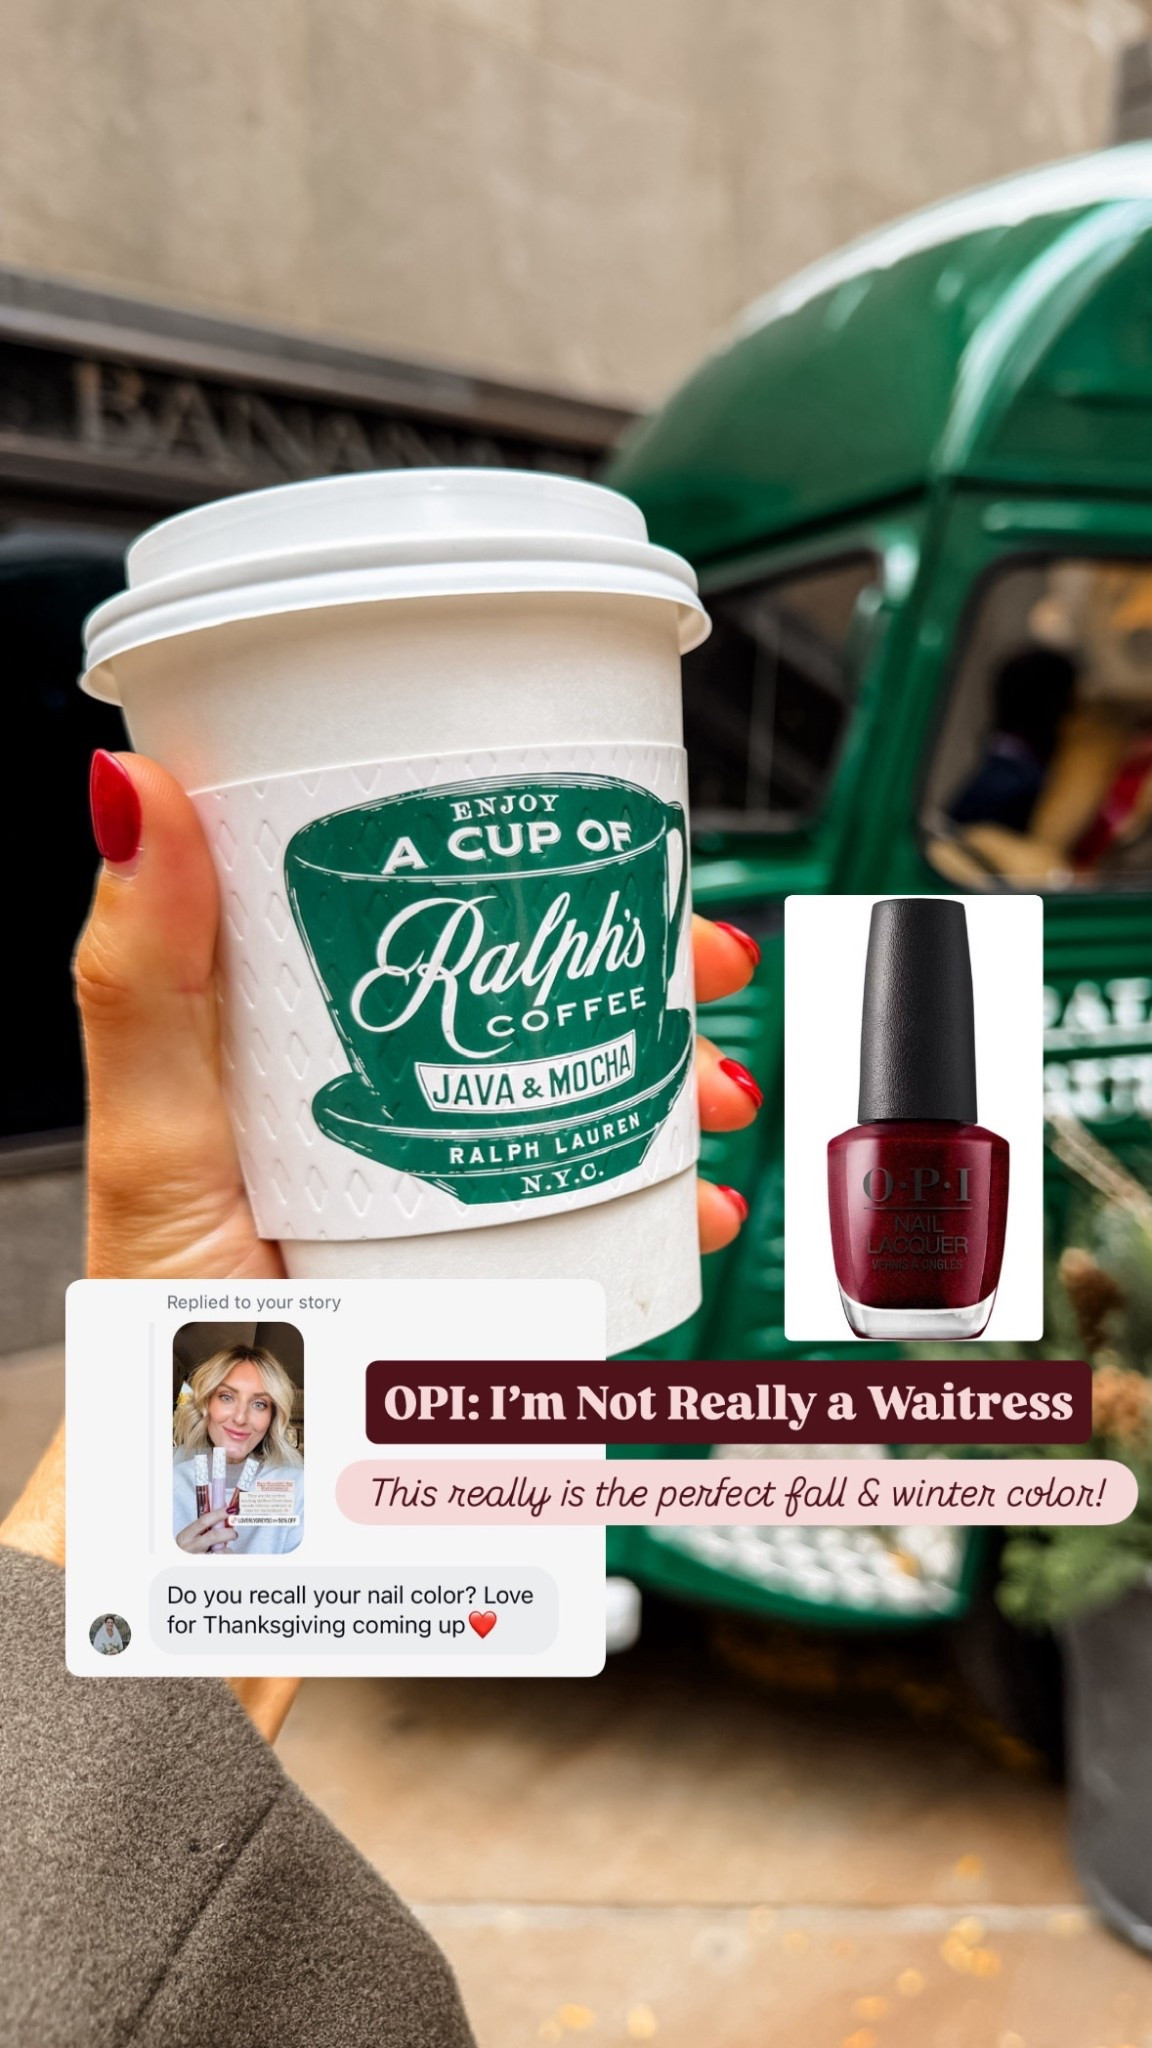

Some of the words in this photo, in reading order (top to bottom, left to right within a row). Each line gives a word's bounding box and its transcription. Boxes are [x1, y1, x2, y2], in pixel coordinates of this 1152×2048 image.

[450, 794, 559, 822] ENJOY
[381, 836, 429, 875] A
[447, 821, 562, 861] CUP
[576, 819, 632, 852] OF
[350, 890, 646, 1059] Ralph's
[486, 986, 647, 1038] COFFEE
[433, 1073, 515, 1105] JAVA
[522, 1077, 544, 1099] &
[548, 1044, 631, 1098] MOCHA
[450, 1141, 540, 1164] RALPH
[555, 1112, 641, 1155] LAUREN
[520, 1162, 604, 1195] N.Y.C.
[895, 1215, 945, 1233] NAIL
[867, 1236, 969, 1255] LACQUER
[922, 1259, 964, 1270] ONGLES
